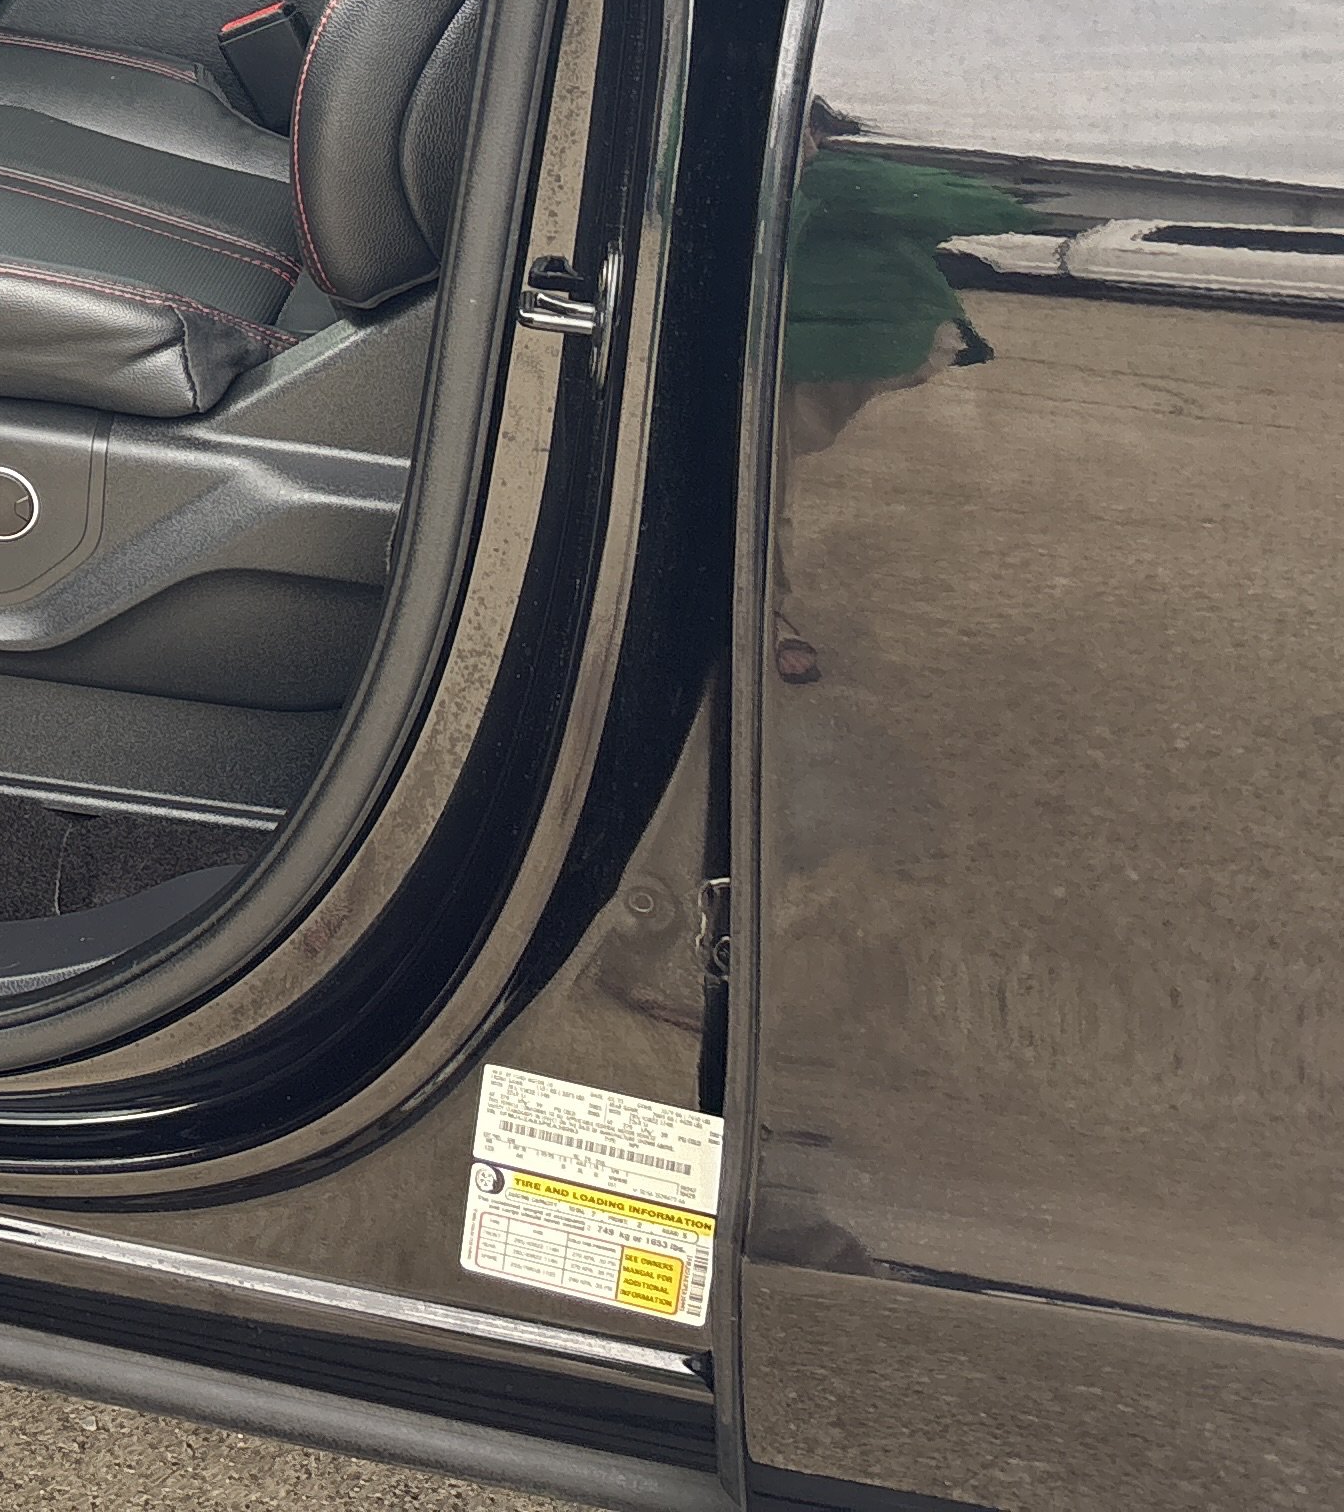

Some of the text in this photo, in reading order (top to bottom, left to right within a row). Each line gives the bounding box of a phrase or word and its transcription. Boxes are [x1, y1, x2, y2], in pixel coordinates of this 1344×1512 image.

[514, 1178, 712, 1231] TIRE AND LOADING INFORMATION
[618, 1231, 631, 1241] kg
[619, 1289, 673, 1307] INFORMATION
